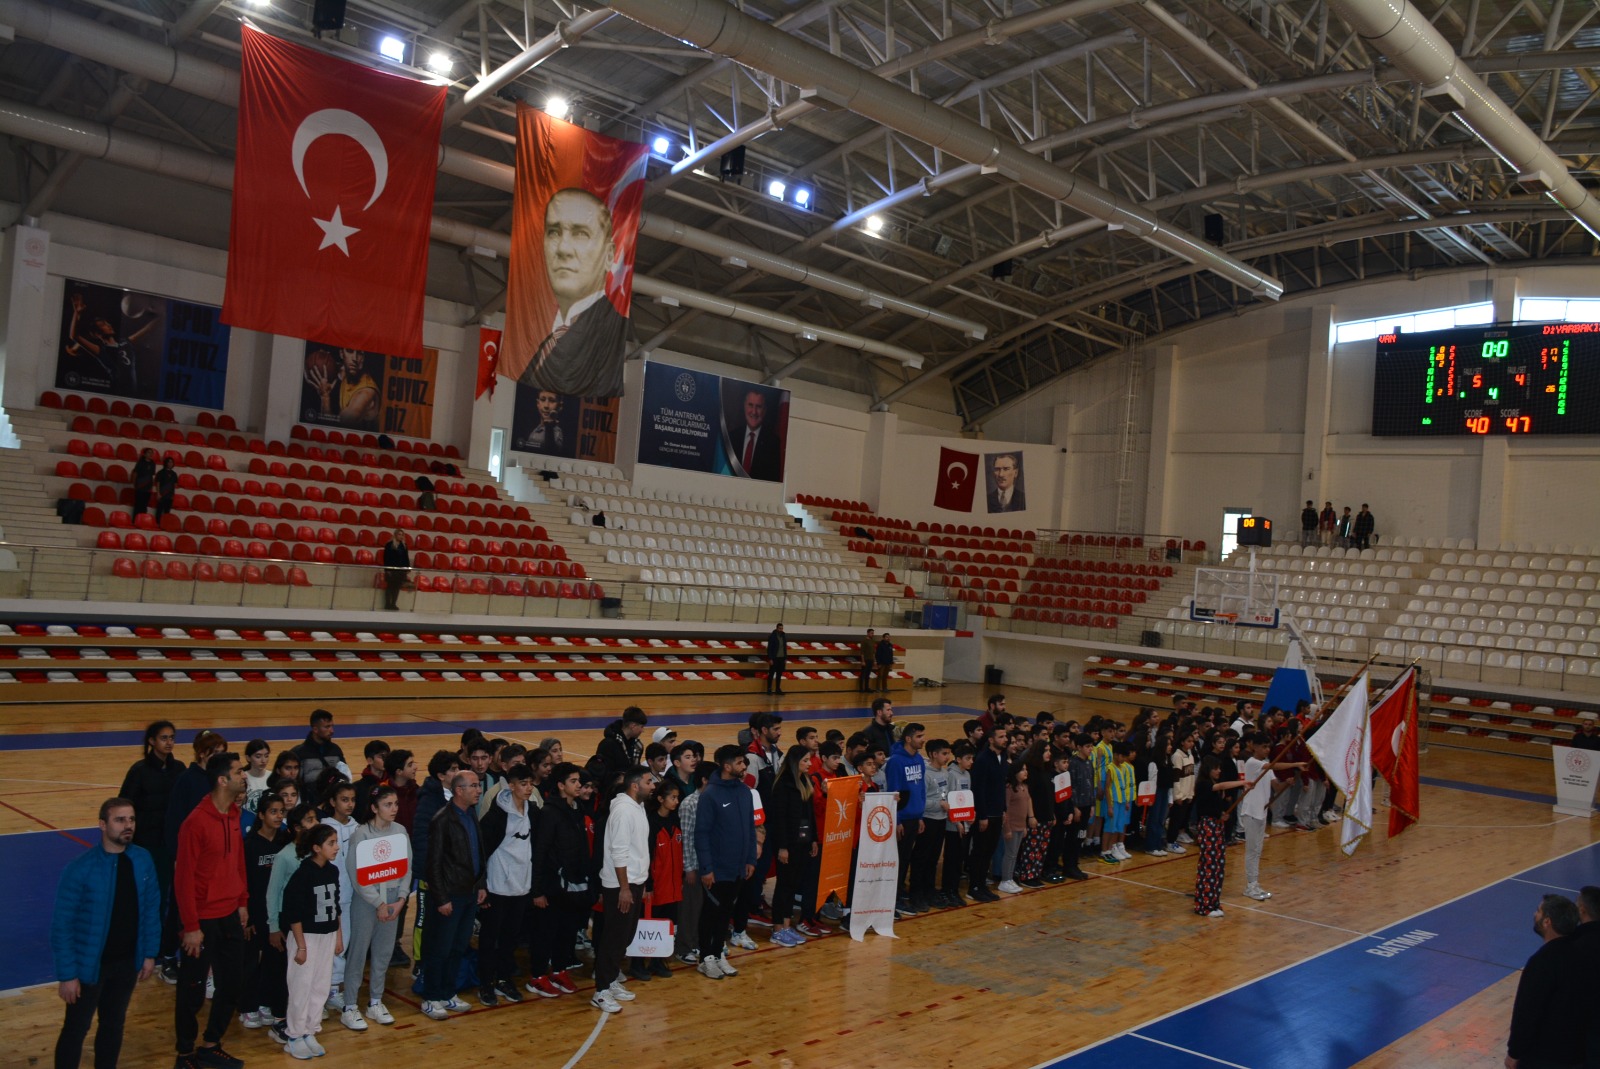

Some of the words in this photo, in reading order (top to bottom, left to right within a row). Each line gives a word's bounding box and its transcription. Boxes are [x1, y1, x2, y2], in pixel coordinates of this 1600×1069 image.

[1379, 334, 1397, 343] VAN
[1482, 341, 1508, 357] 0:0
[1472, 374, 1482, 388] 5
[1515, 374, 1525, 386] 4
[1488, 387, 1498, 400] 4
[653, 414, 661, 423] VE
[661, 407, 674, 417] TÜM
[675, 410, 706, 422] ANTRENÖR
[1464, 410, 1482, 418] SCORE
[1500, 408, 1519, 417] SCORE
[1466, 417, 1490, 434] 40
[1505, 417, 1531, 433] 47
[825, 829, 852, 843] hürriyet
[368, 867, 398, 881] MARDİN
[313, 883, 338, 923] H
[638, 930, 662, 941] VAN
[1365, 929, 1439, 958] BATMAN
